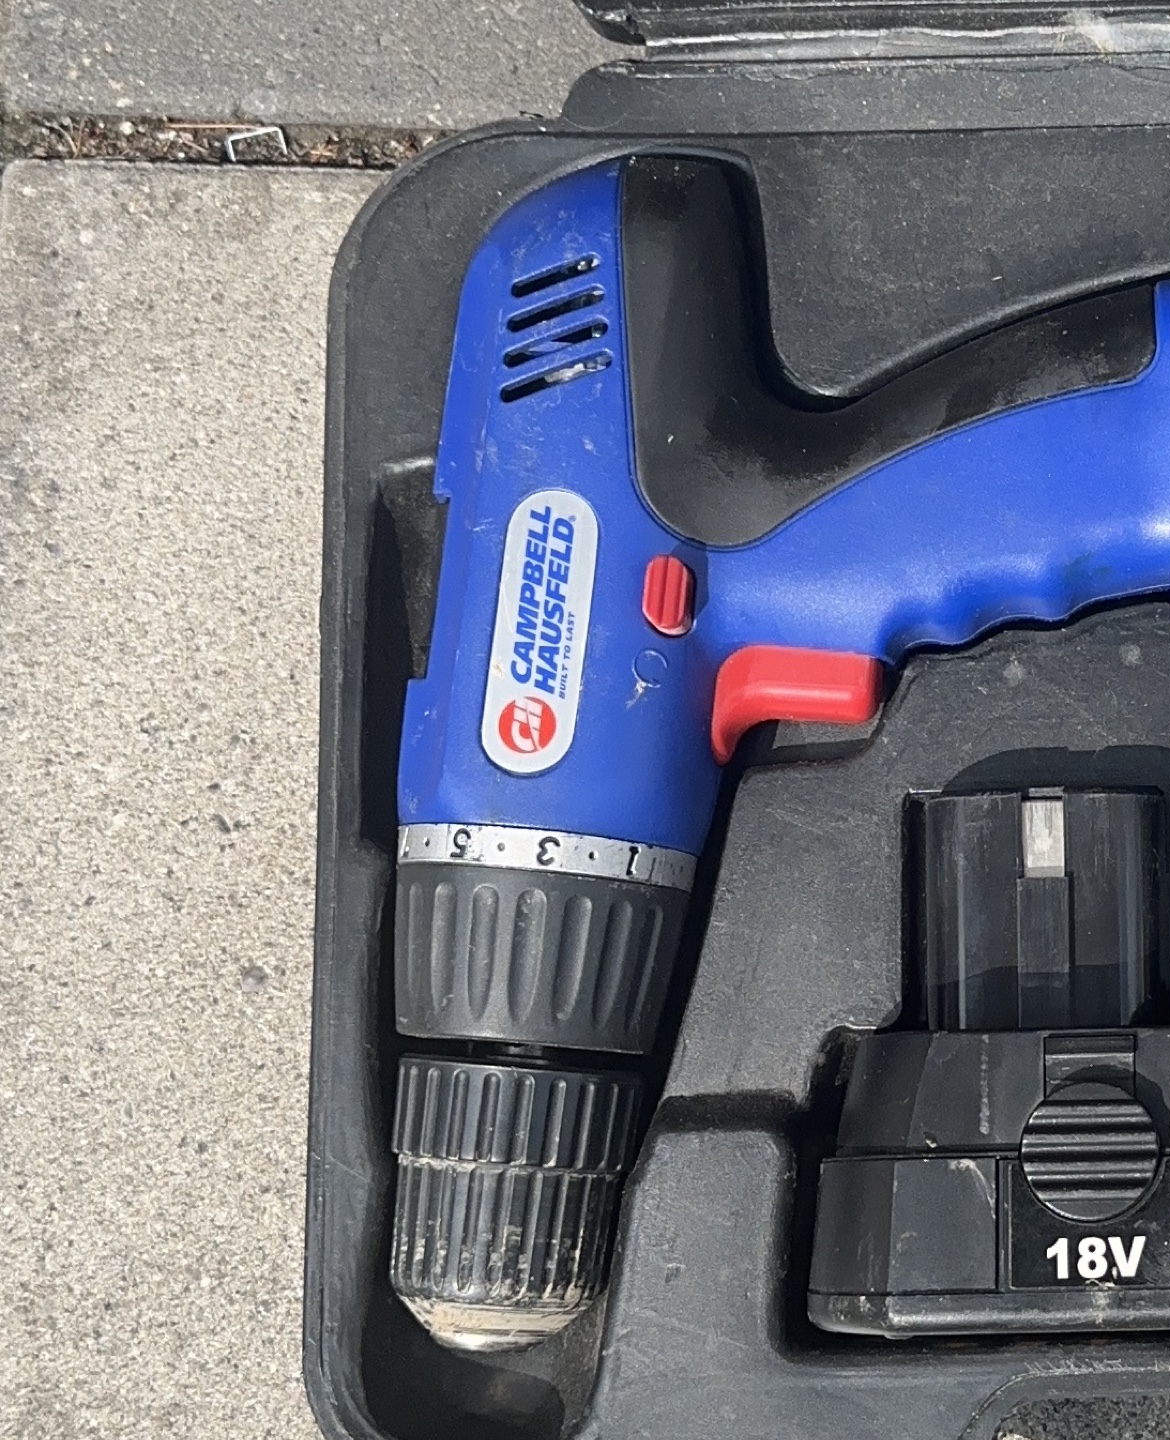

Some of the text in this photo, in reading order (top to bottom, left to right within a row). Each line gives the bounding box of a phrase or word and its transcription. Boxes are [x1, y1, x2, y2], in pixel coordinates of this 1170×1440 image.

[510, 506, 552, 684] CAMPBELL
[534, 517, 576, 695] HAUSFELD
[558, 611, 576, 700] BUILT TO LAST
[450, 828, 471, 858] 5
[536, 836, 560, 866] 3
[1045, 1236, 1146, 1280] 18V
